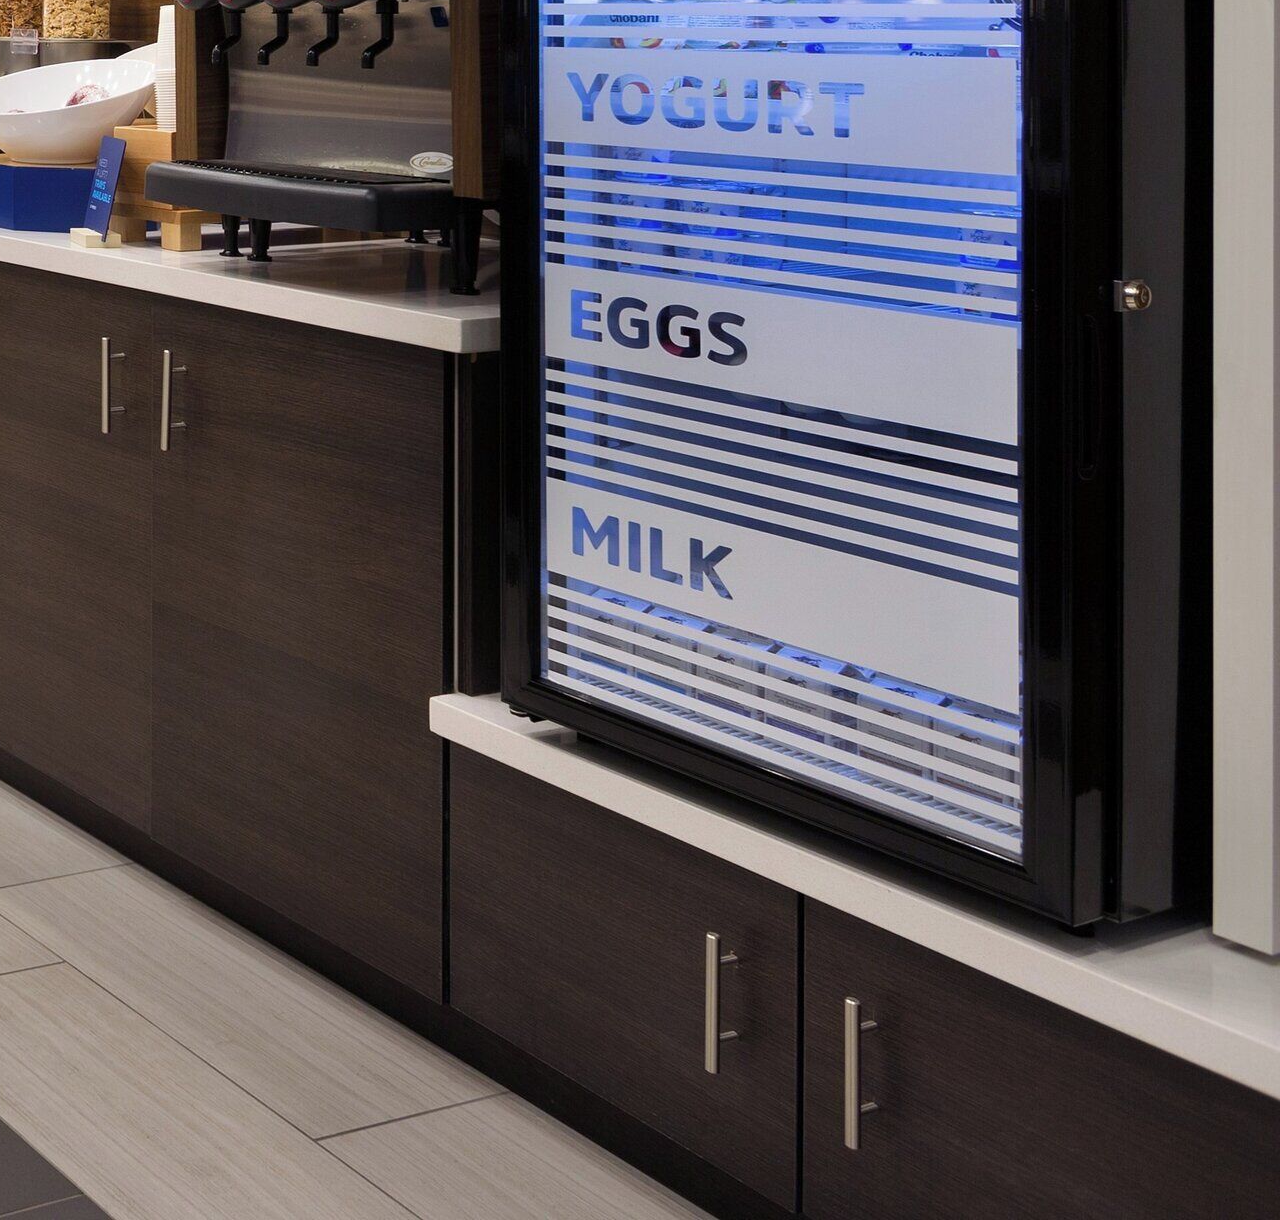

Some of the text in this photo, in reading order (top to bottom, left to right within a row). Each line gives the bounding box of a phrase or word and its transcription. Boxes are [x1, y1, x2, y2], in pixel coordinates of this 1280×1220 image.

[566, 71, 866, 138] YOGURT
[570, 288, 749, 367] EGGS
[571, 506, 735, 601] MILK
